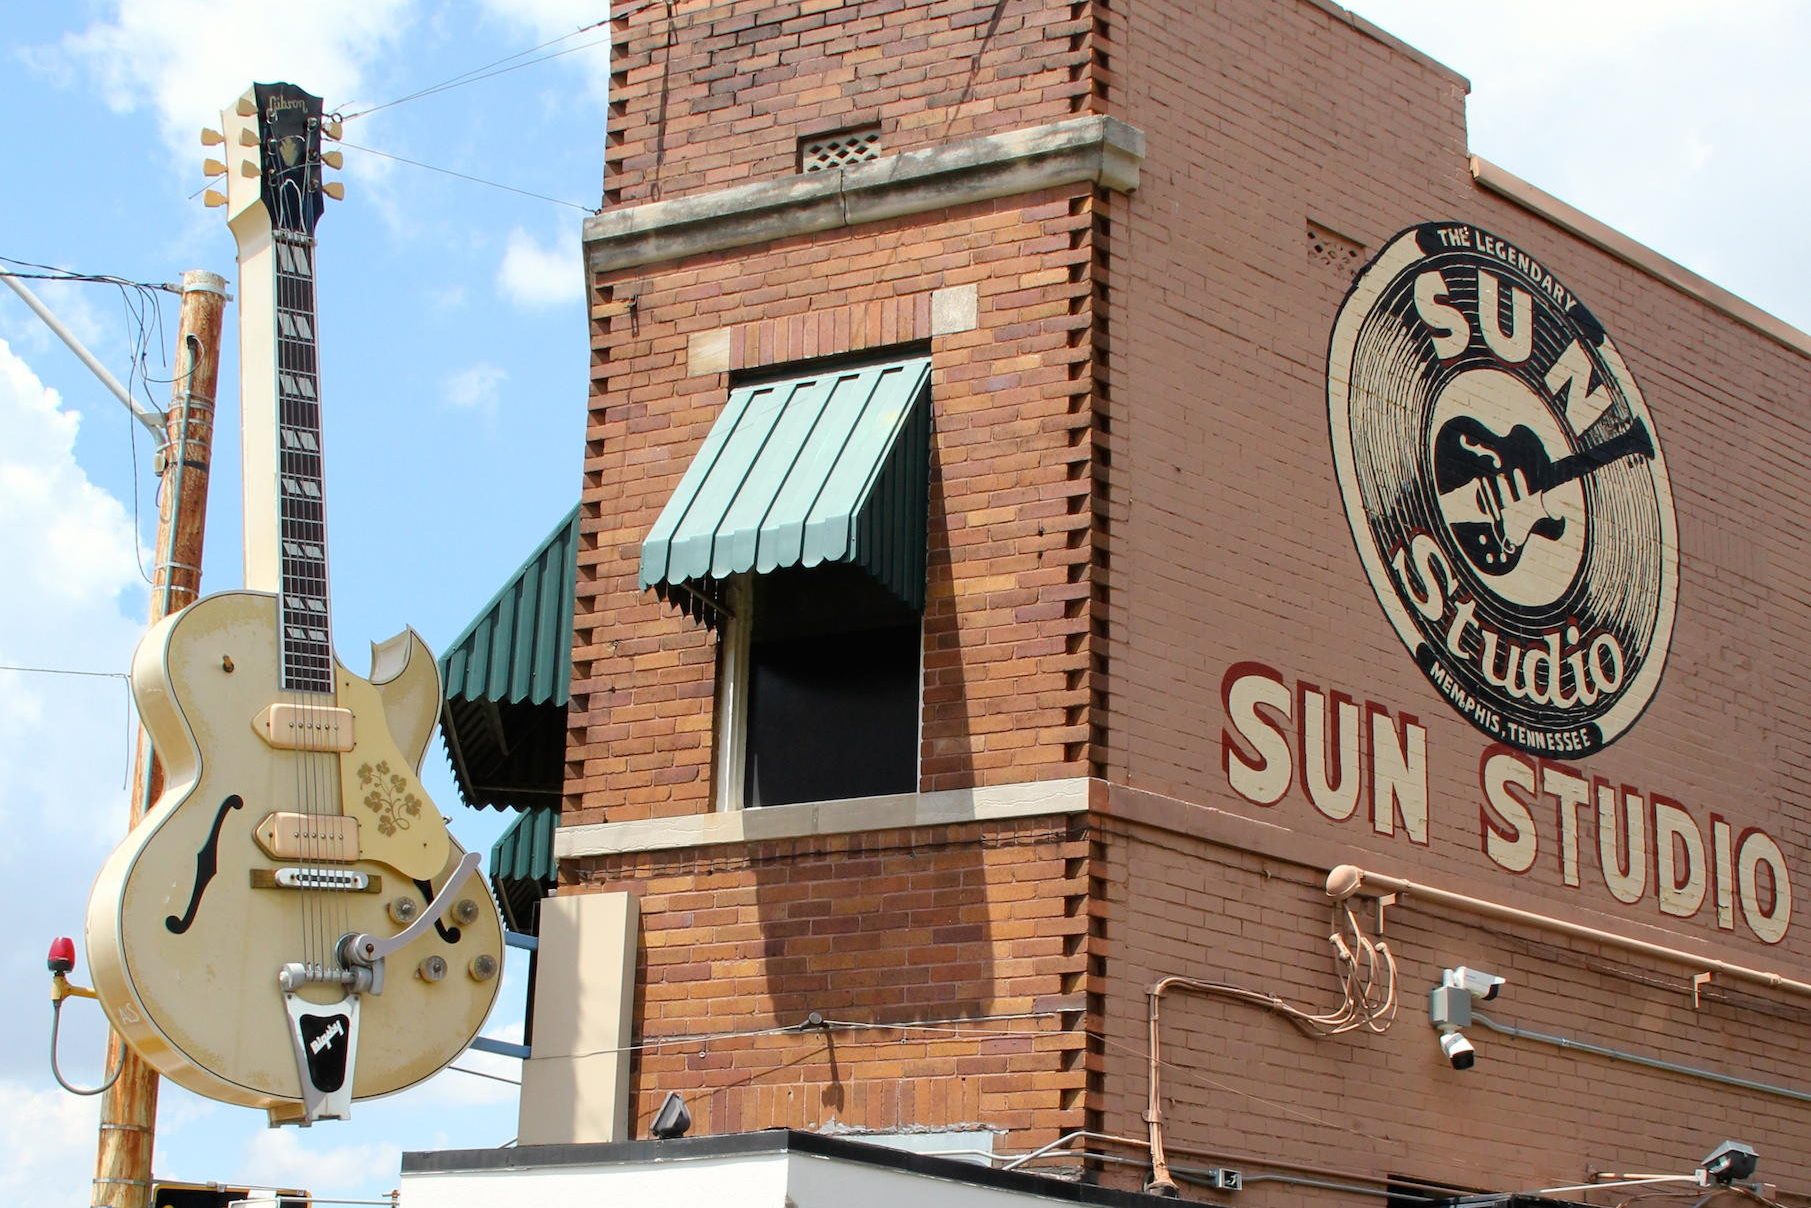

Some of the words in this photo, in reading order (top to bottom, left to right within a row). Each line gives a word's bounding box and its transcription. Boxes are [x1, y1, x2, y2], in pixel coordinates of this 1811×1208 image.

[267, 95, 308, 114] Gibson
[1437, 227, 1471, 247] THE
[1475, 230, 1577, 312] LEGENDARY
[1413, 270, 1614, 438] SUN
[1392, 533, 1625, 709] Studio
[1429, 660, 1506, 738] MEMPHIS,
[1507, 721, 1591, 752] TENNESSEE
[1223, 664, 1428, 846] SUN
[1480, 746, 1792, 944] STUDIO
